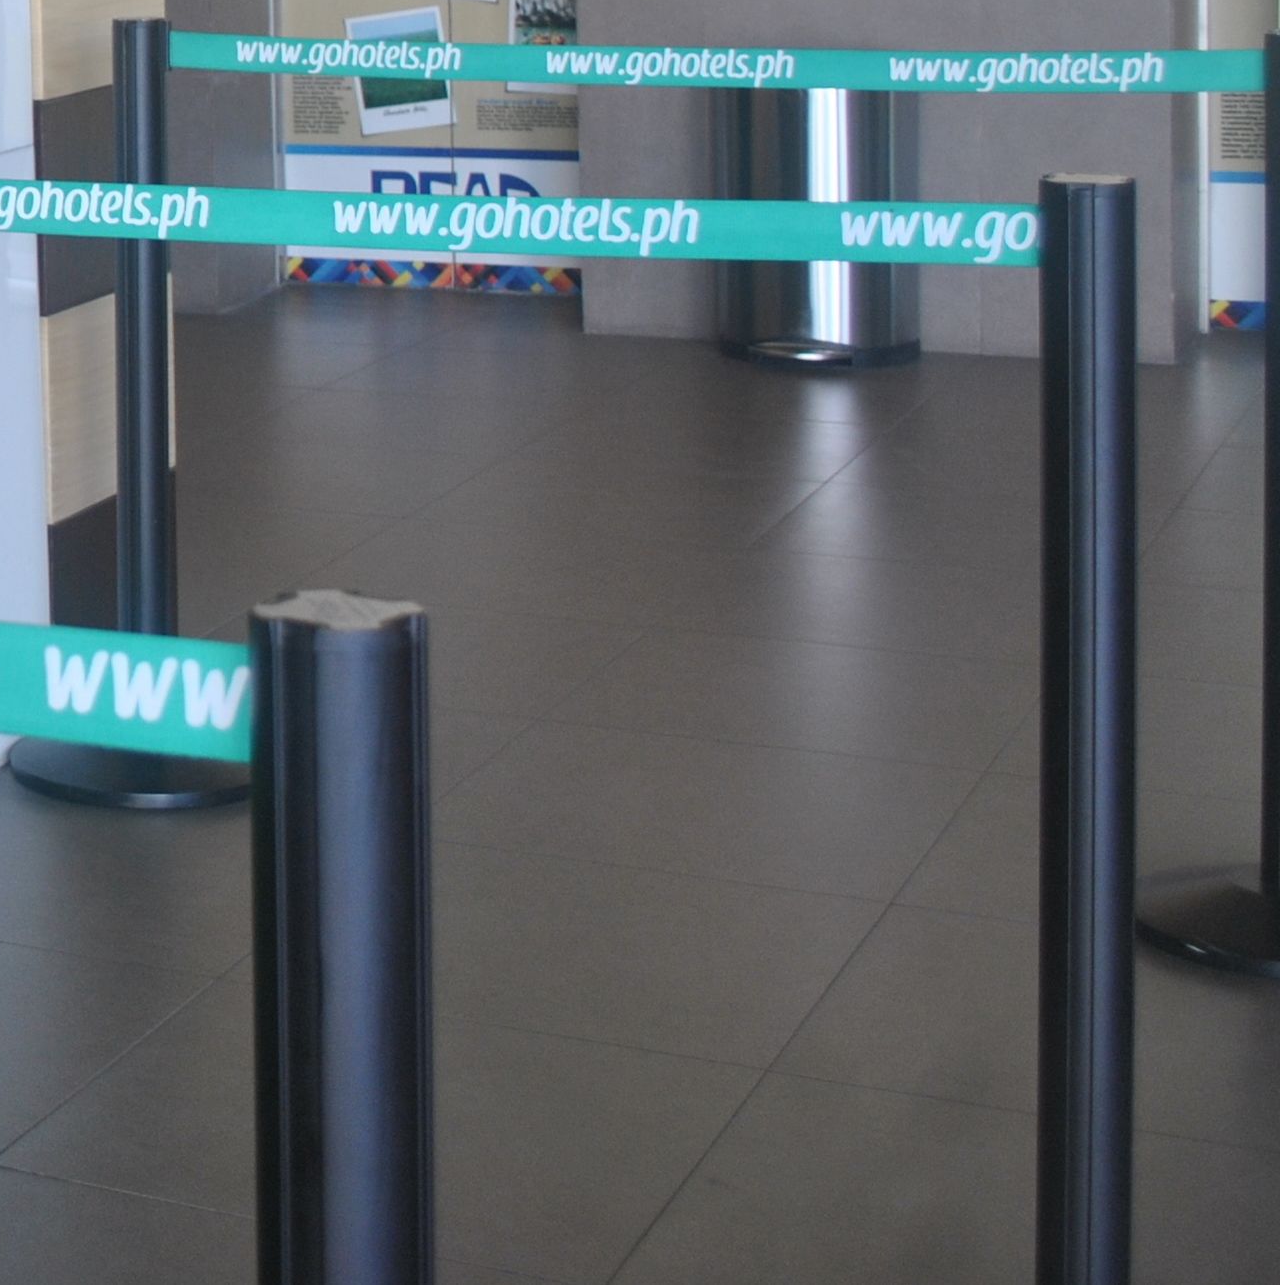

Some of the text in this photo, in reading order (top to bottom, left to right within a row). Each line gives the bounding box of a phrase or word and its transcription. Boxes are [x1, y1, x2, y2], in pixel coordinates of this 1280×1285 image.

[236, 39, 1164, 92] www.gohotels.ph www.gohotels.ph www.gohotels.ph
[332, 196, 699, 256] www.gohotels.ph
[841, 208, 1038, 264] www.go
